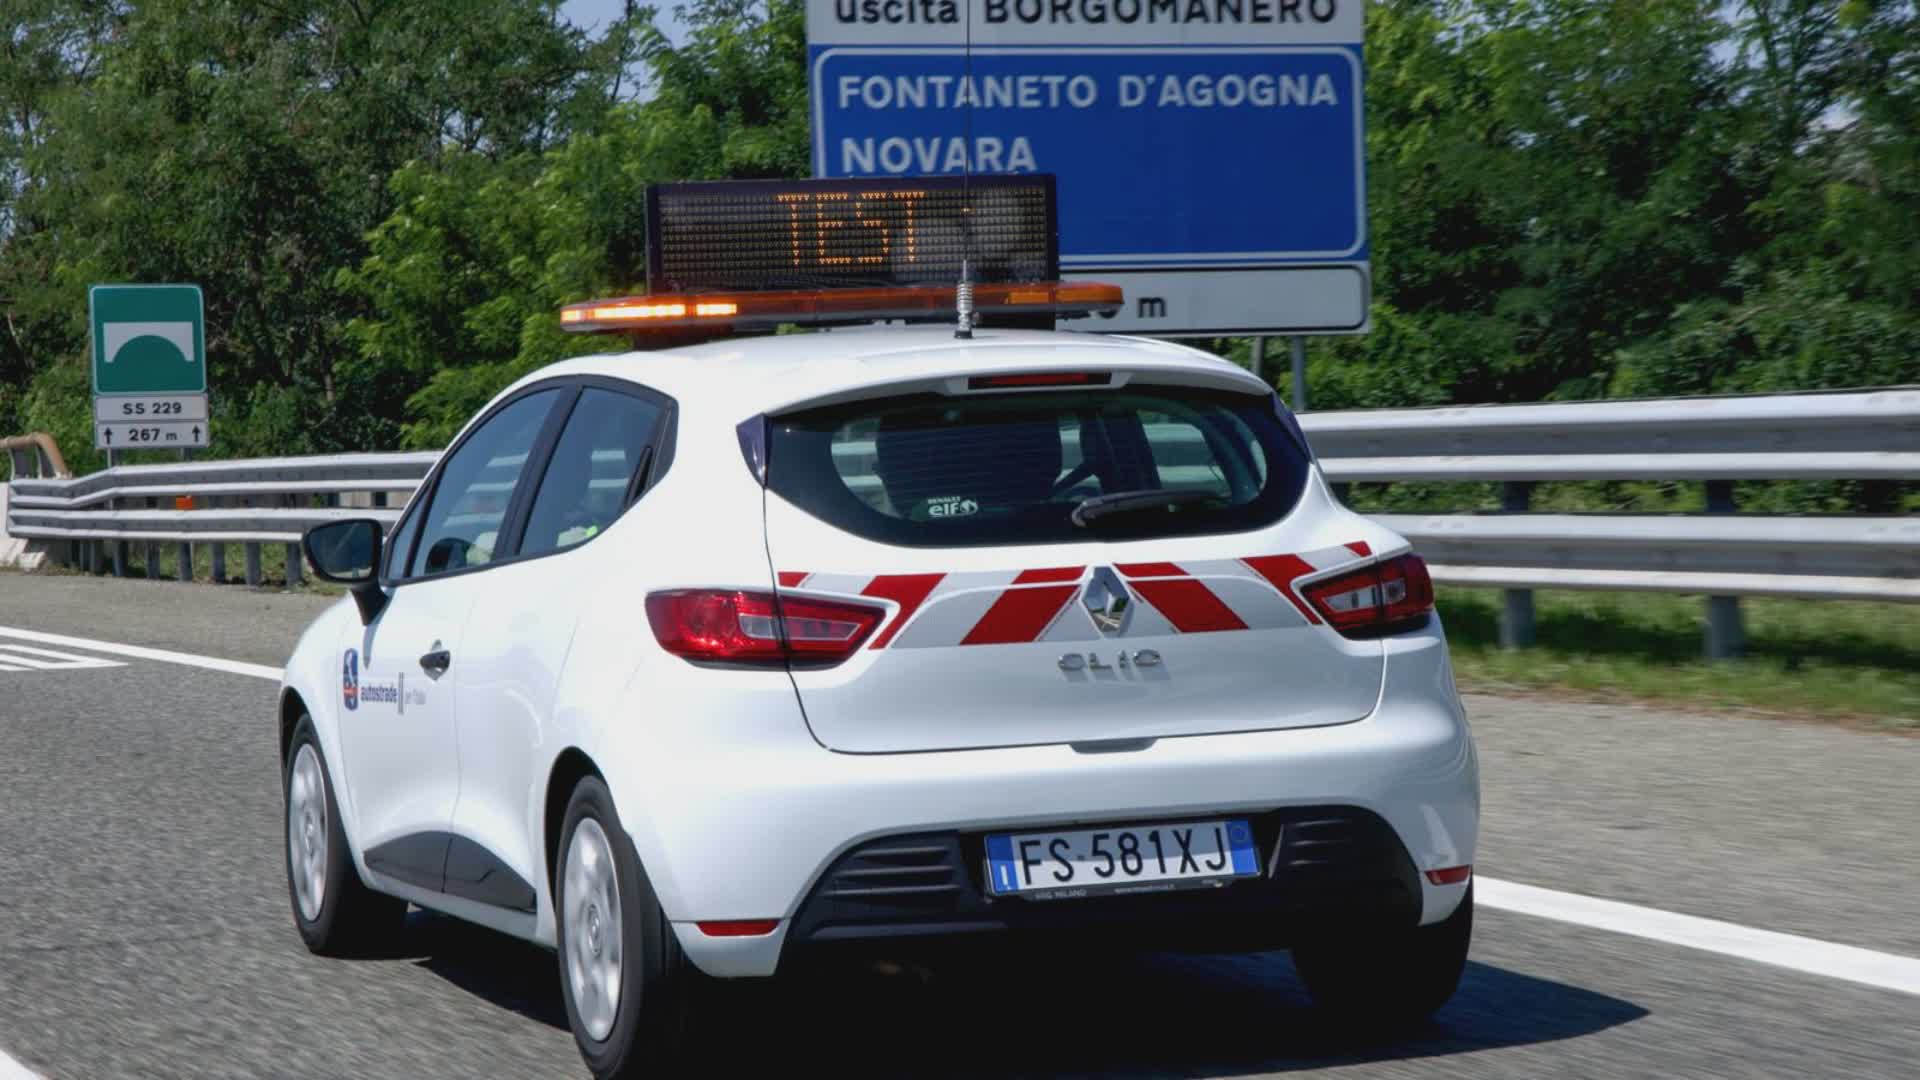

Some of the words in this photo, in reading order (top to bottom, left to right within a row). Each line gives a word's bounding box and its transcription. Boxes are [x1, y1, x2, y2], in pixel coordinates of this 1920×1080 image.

[835, 0, 960, 24] uscita
[984, 0, 1336, 24] BORGOMANERO
[837, 74, 1097, 109] FONTANETO
[1118, 73, 1338, 107] D'AGOGNA
[842, 137, 1036, 173] NOVARA
[777, 191, 925, 266] TEST
[1137, 296, 1168, 318] m
[122, 402, 145, 415] SS
[152, 402, 182, 414] 229
[128, 429, 160, 441] 267
[165, 431, 177, 440] m
[928, 502, 959, 517] elf
[1058, 649, 1161, 671] CLIO
